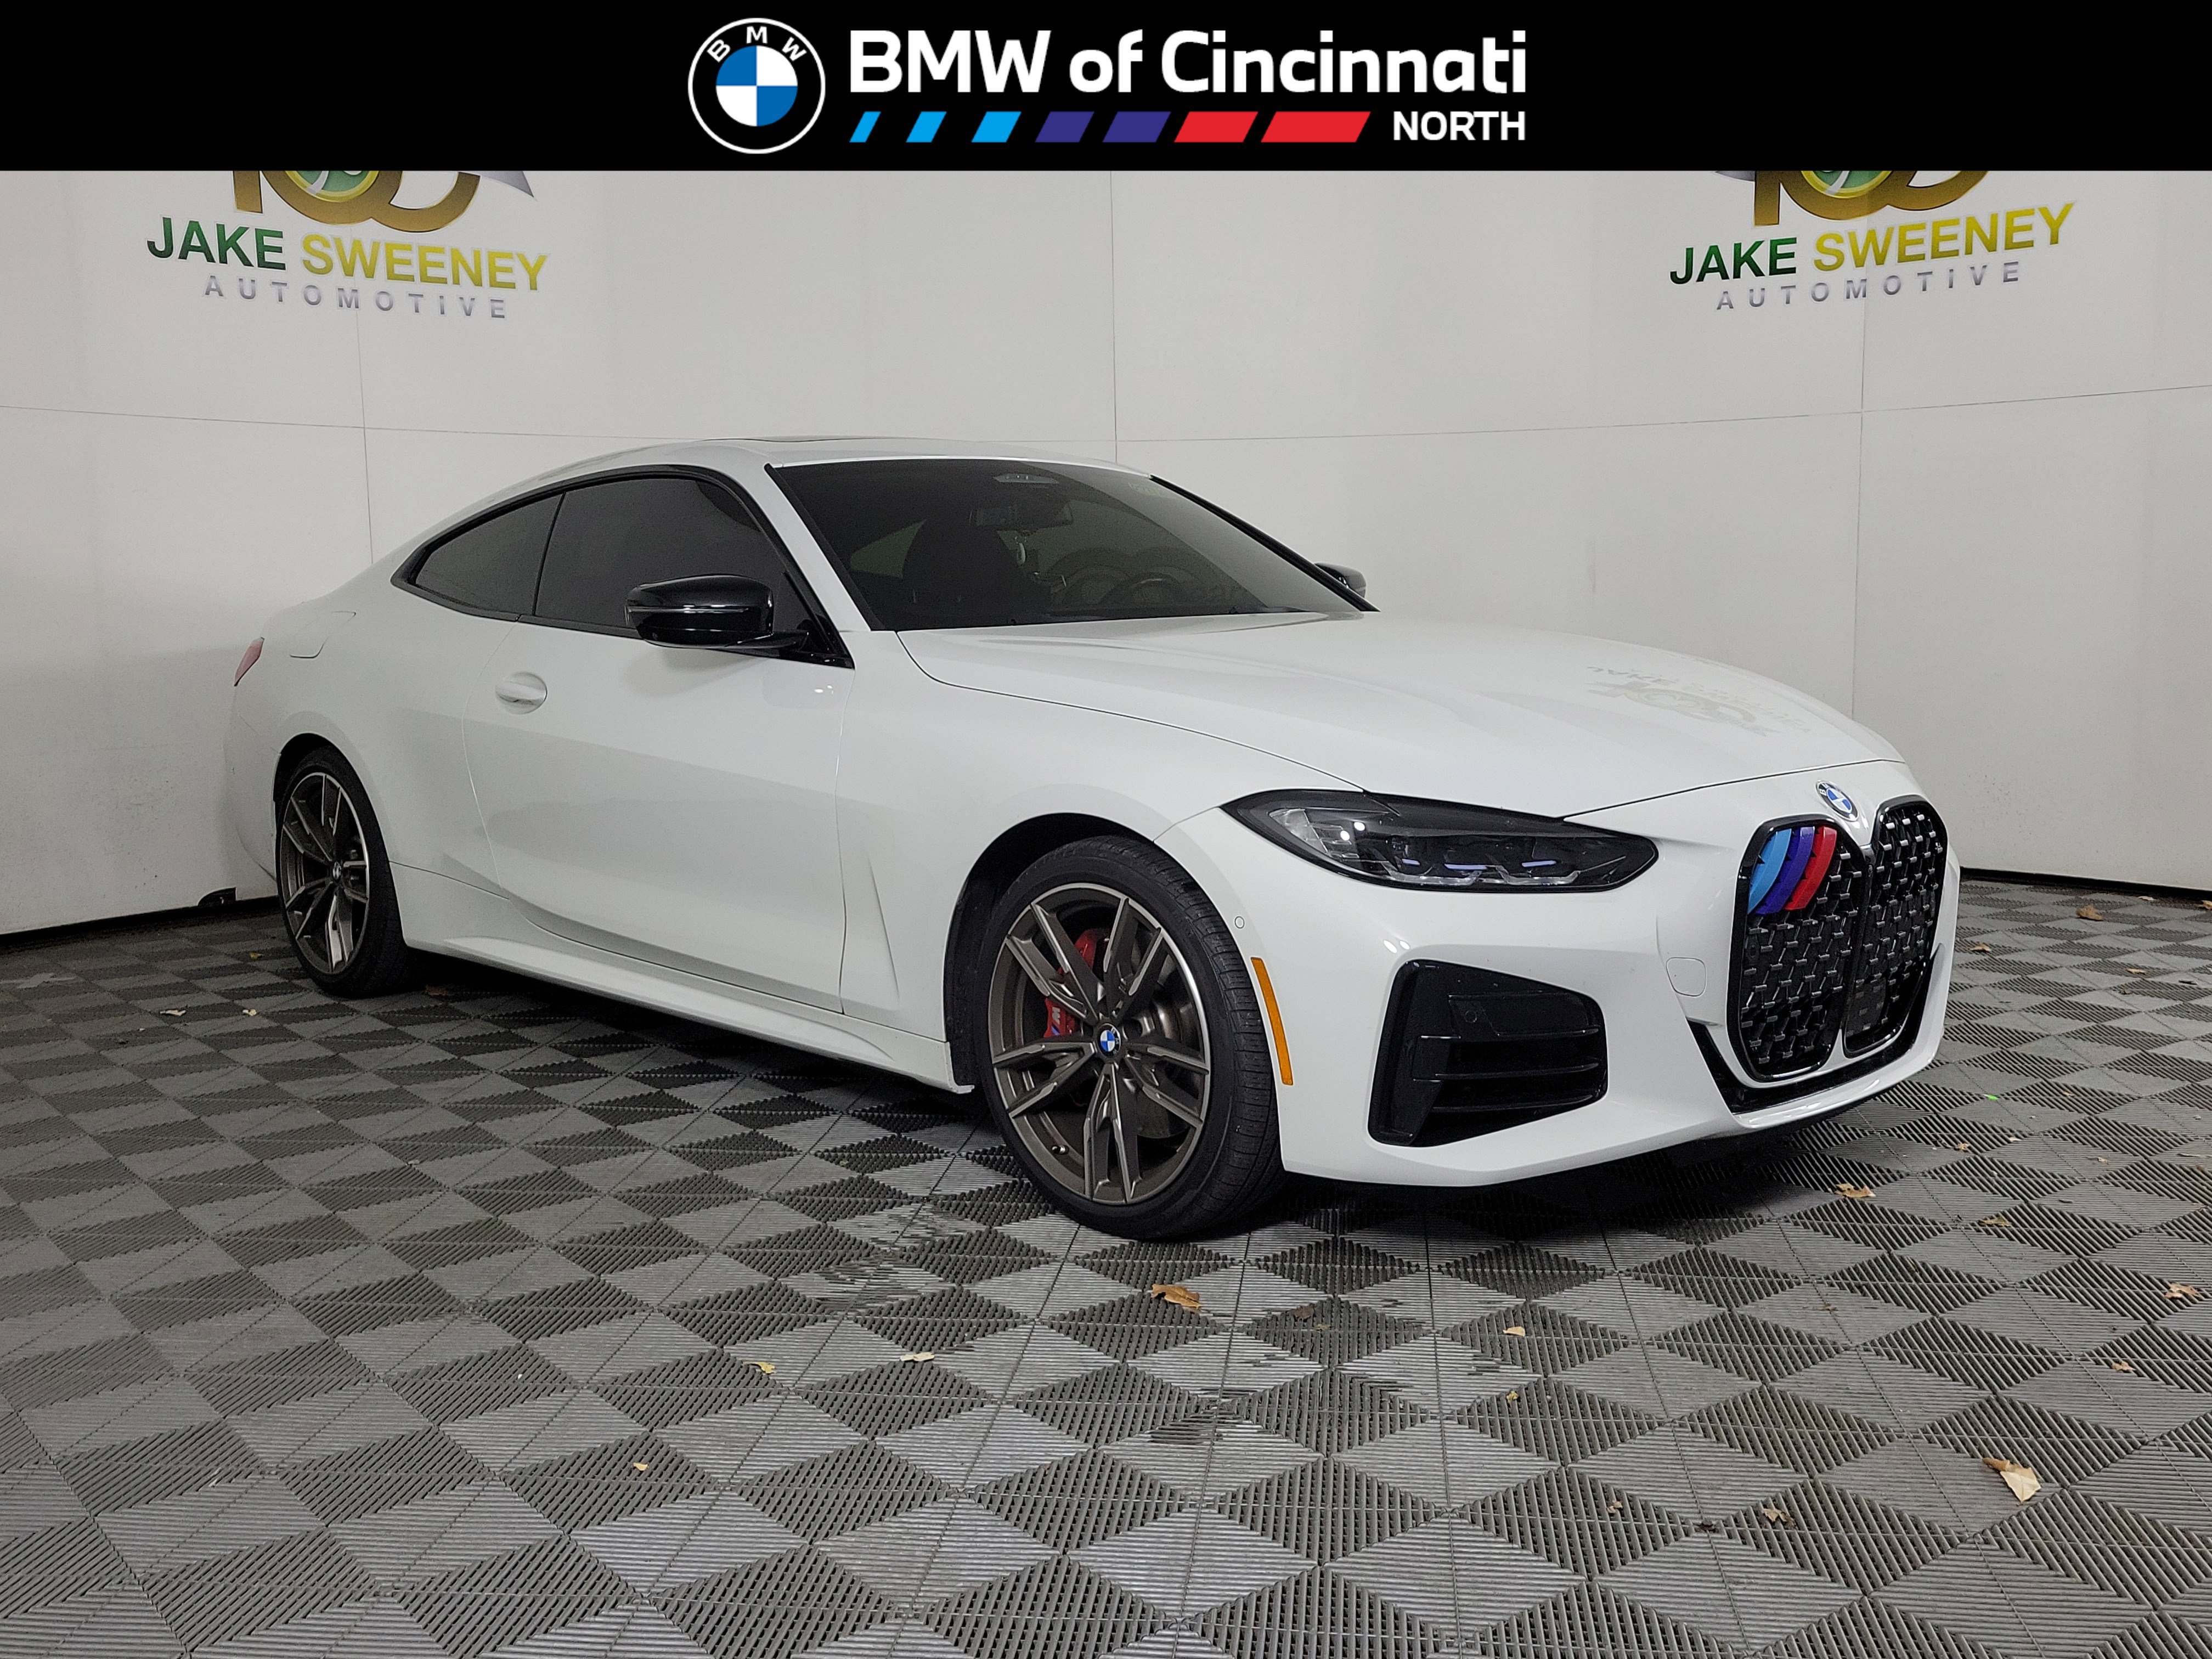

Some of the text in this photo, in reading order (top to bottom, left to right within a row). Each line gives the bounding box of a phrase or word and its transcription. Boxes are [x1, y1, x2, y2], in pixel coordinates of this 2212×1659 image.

[147, 217, 547, 291] JAKE SWEENEY
[1670, 203, 2074, 285] JAKE SWEENEY
[205, 275, 505, 319] AUTOMOTIVE
[1717, 261, 2019, 311] AUTOMOTIVE
